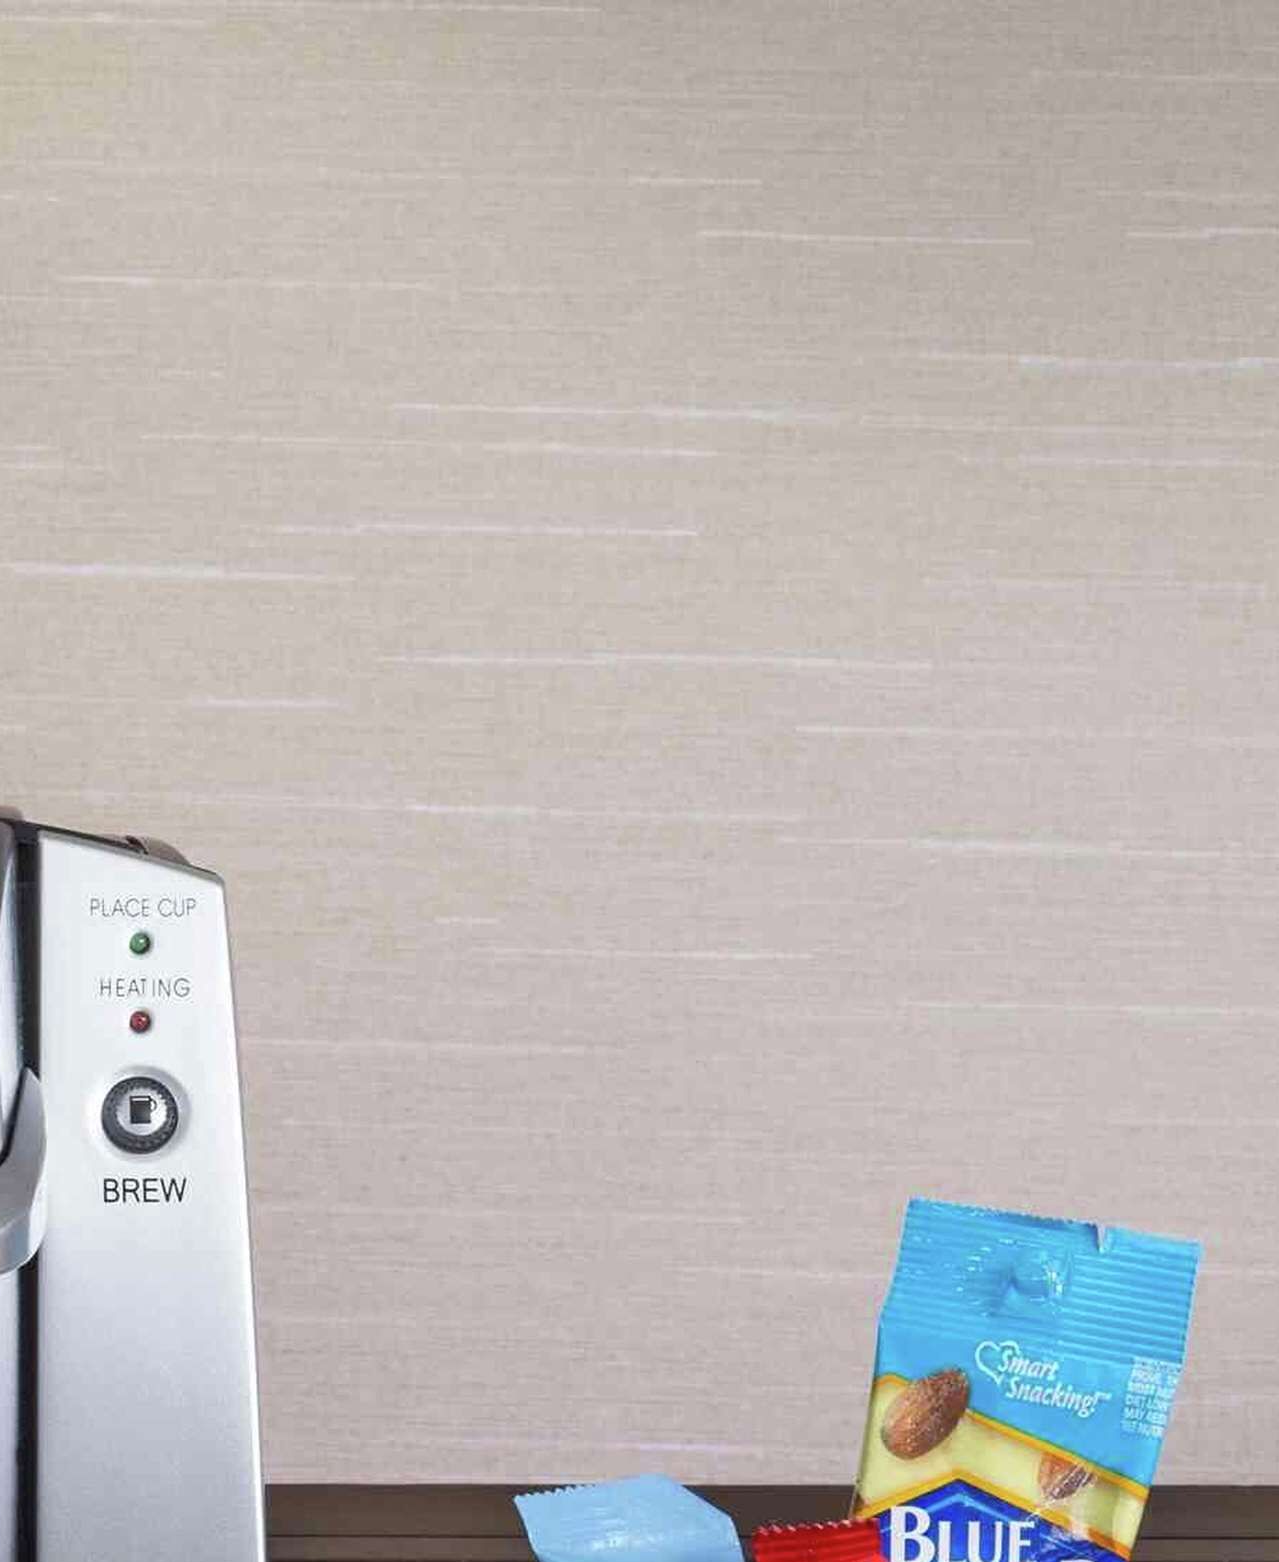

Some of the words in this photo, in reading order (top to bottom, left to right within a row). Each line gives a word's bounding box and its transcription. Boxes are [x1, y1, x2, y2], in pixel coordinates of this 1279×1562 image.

[89, 898, 150, 917] PLACE
[157, 898, 197, 917] CUP
[99, 977, 191, 998] HEATING
[102, 1177, 187, 1203] BREW
[997, 1347, 1060, 1381] Smart
